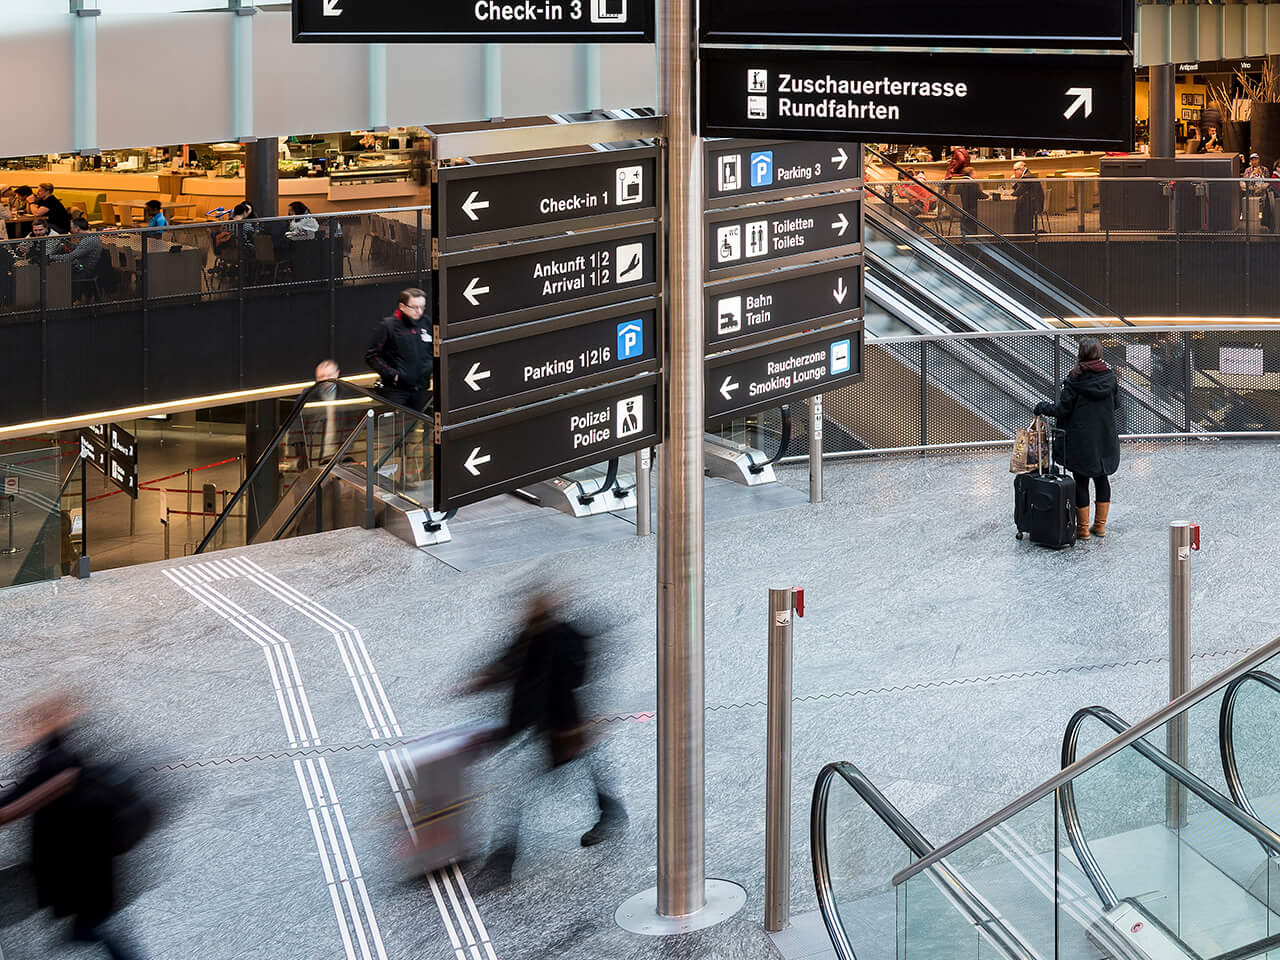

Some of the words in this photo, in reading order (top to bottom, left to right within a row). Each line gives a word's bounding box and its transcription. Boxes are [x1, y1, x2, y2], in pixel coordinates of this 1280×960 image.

[475, 0, 562, 20] Check-in
[571, 0, 581, 19] 3
[779, 74, 967, 97] Zuschauerterrasse
[779, 98, 899, 119] Rundfahrten
[778, 166, 810, 180] Parking
[815, 163, 821, 175] 3
[540, 194, 597, 213] Check-in
[603, 192, 607, 204] 1
[772, 218, 813, 234] Toiletten
[772, 234, 804, 250] Toilets
[534, 256, 585, 280] Ankunft
[541, 273, 584, 295] Arrival
[746, 294, 772, 309] Bahn
[746, 310, 770, 325] Train
[524, 360, 575, 382] Parking
[768, 351, 826, 374] Raucherzone
[749, 372, 792, 396] Smoking
[793, 364, 826, 388] Lounge
[571, 407, 610, 432] Polizei
[573, 426, 610, 449] Police
